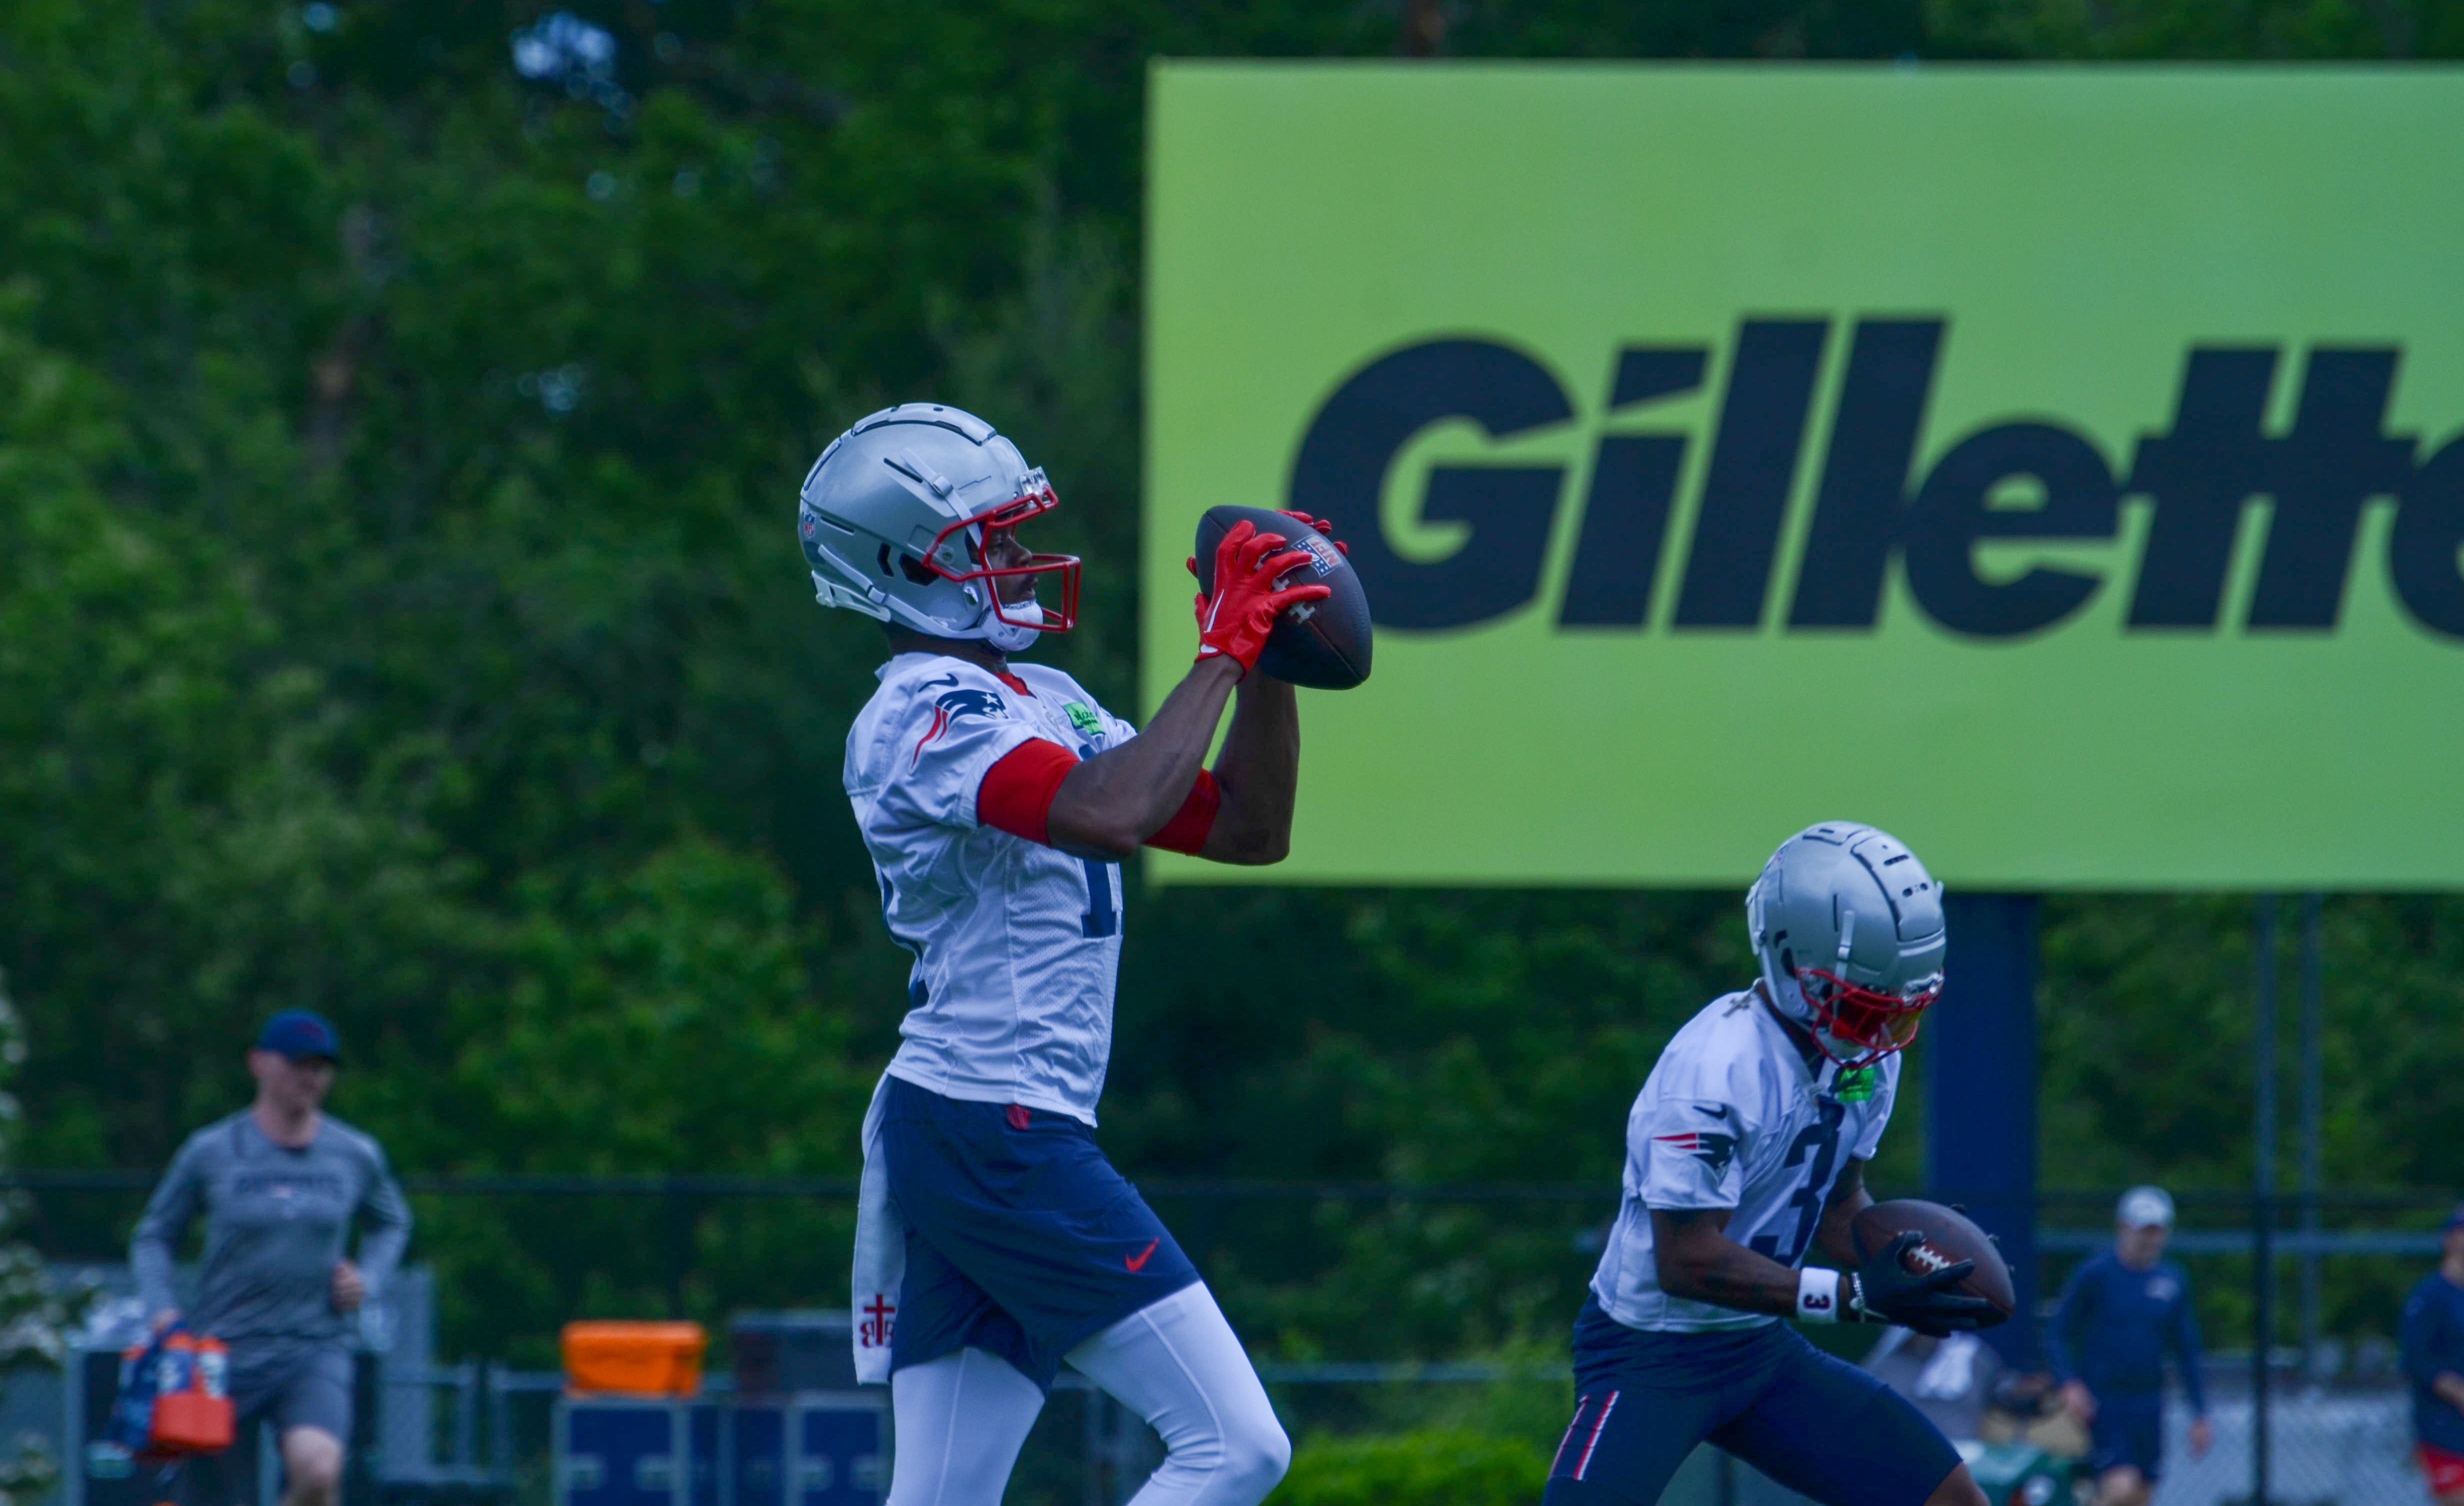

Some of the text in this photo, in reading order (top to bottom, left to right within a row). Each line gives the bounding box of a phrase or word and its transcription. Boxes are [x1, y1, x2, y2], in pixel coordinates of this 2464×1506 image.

[1310, 540, 1340, 566] NFL
[1748, 1123, 1838, 1271] 3
[1803, 1294, 1830, 1310] 3
